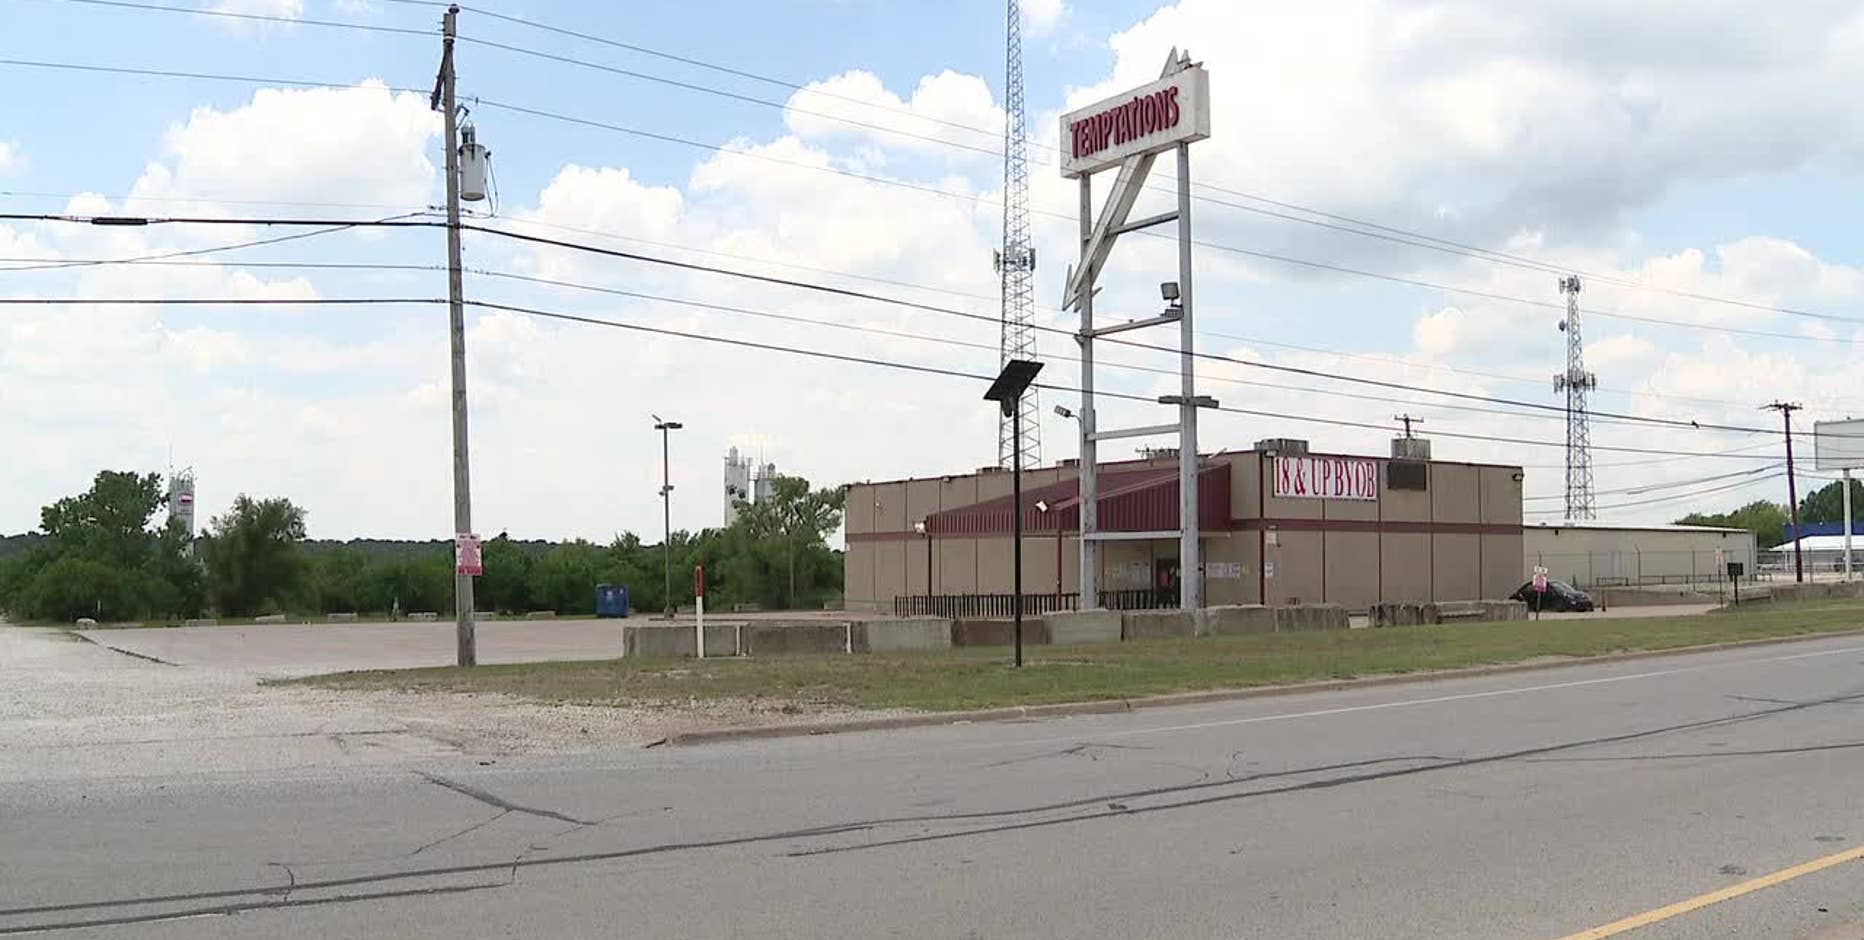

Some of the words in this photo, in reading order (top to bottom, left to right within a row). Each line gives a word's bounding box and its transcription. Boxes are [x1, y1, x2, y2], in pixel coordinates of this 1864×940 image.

[1070, 86, 1179, 159] TEMPTATIONS
[1276, 456, 1290, 494] 18
[1294, 457, 1306, 495] &
[1311, 458, 1331, 496] UP
[1334, 460, 1375, 498] BYOB
